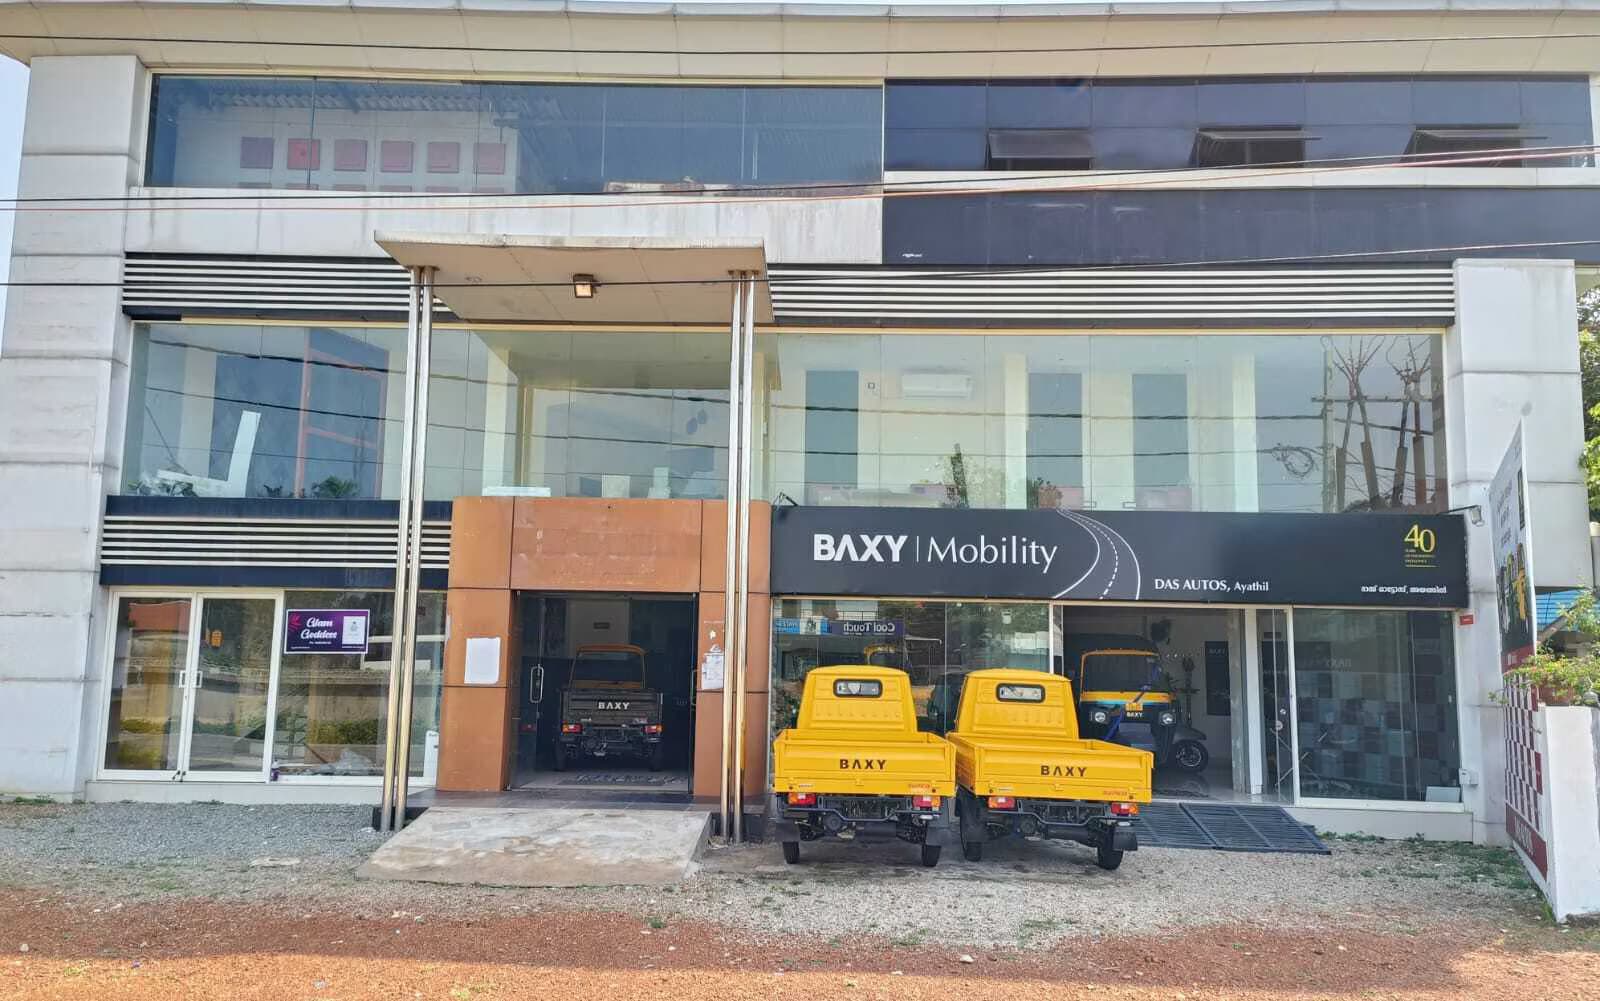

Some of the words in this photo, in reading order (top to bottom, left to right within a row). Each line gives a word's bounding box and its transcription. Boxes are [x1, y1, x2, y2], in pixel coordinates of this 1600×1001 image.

[1404, 524, 1436, 553] 40
[813, 534, 908, 562] BAXY
[927, 535, 1058, 573] Mobility
[1154, 578, 1180, 591] DAS
[1182, 579, 1231, 593] AUTOS,
[1233, 580, 1269, 594] Ayathil
[598, 701, 630, 710] BAXY
[839, 758, 886, 770] BAXY
[1040, 765, 1087, 777] BAXY
